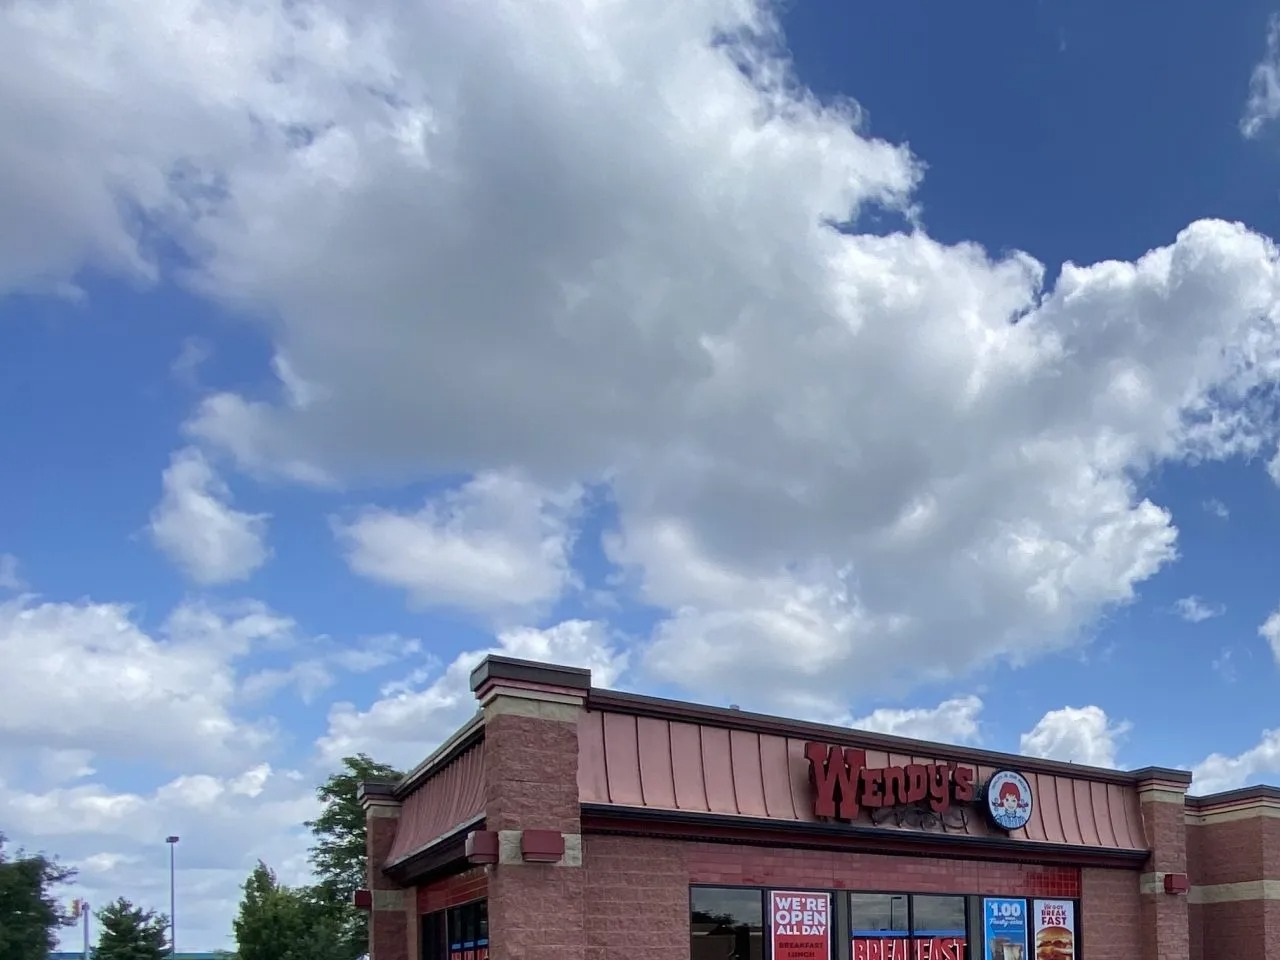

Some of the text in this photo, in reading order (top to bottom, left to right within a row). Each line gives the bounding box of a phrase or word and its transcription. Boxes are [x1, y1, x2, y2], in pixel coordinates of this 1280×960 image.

[775, 897, 826, 911] WE'RE
[775, 911, 826, 925] OPEN
[1041, 916, 1067, 925] FAST
[776, 925, 826, 935] ALL DAY
